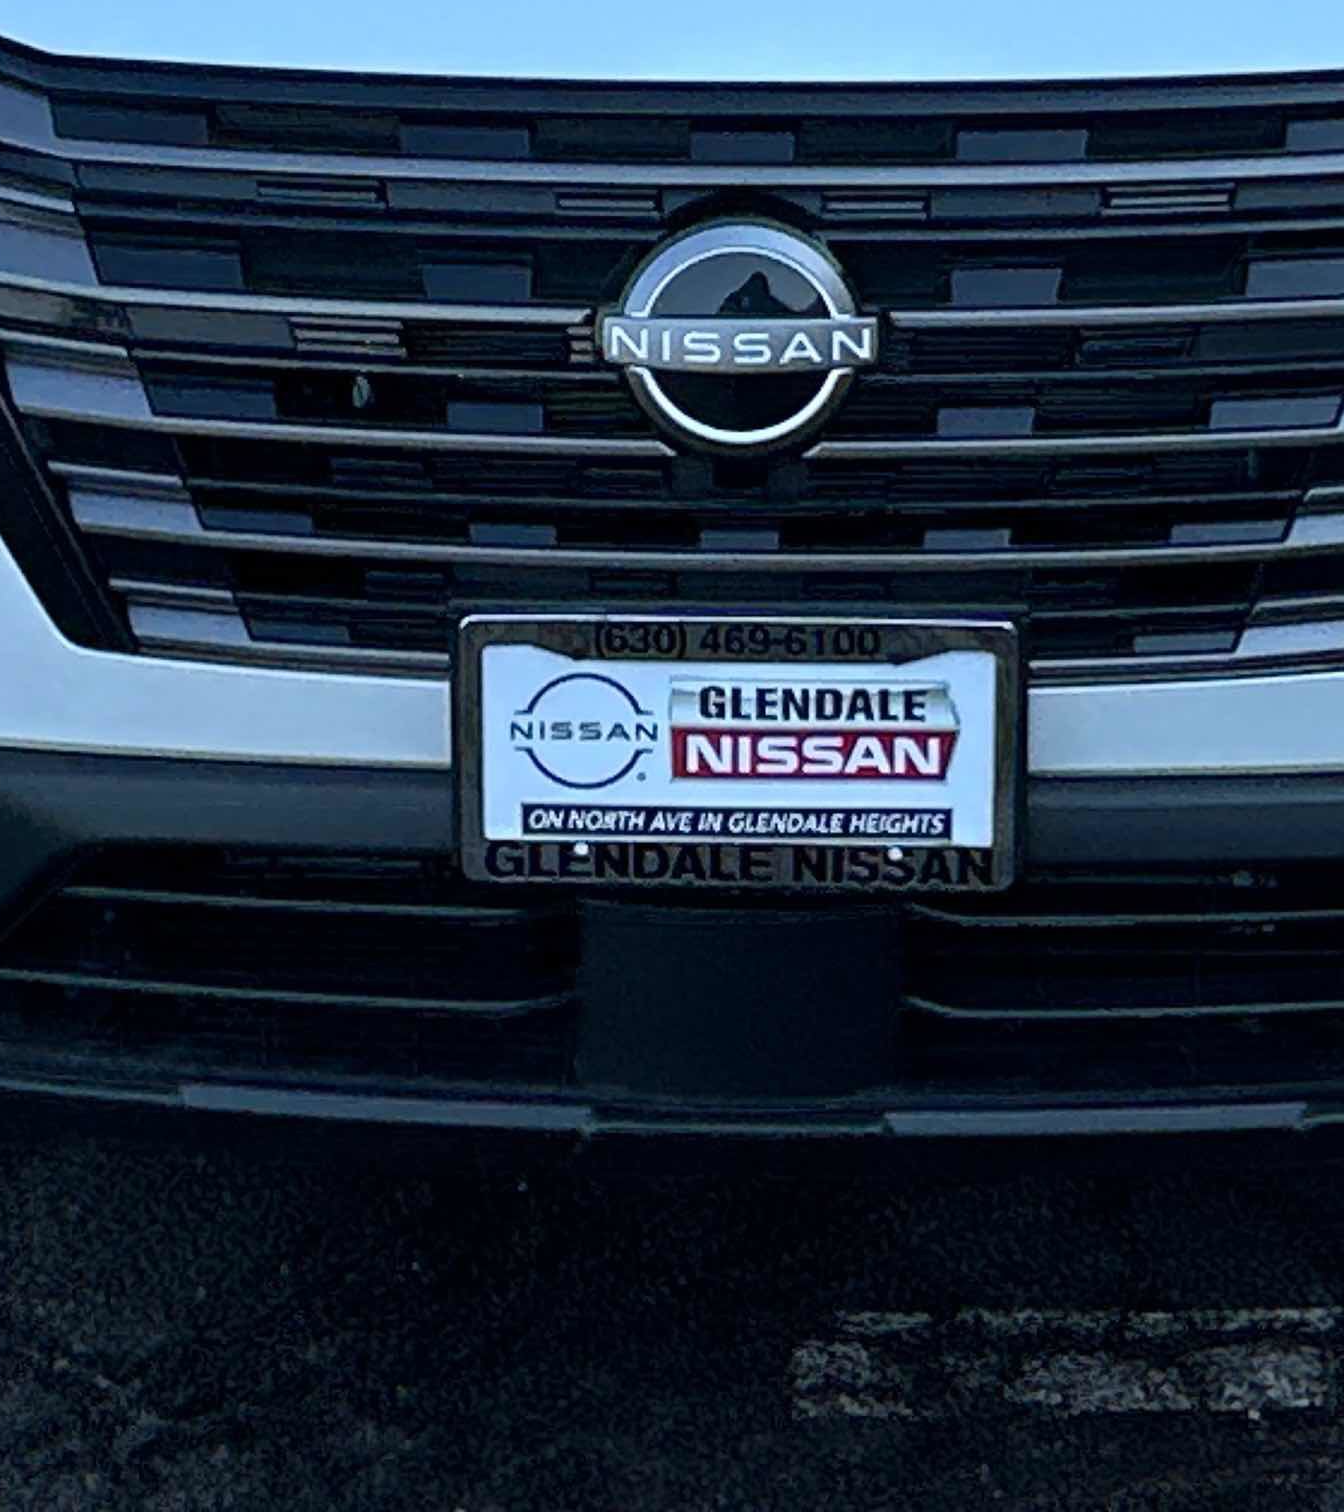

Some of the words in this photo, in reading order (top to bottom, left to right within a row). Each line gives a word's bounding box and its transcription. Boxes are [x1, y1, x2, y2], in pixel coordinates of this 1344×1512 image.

[610, 325, 871, 365] NISSAN
[594, 622, 687, 659] (630)
[700, 624, 881, 657] 469-6100
[699, 685, 927, 723] GLENDALE
[509, 719, 659, 743] NISSAN
[684, 734, 943, 777] NISSAN
[528, 808, 564, 830] ON
[567, 809, 646, 832] NORTH
[648, 810, 694, 833] AVE
[697, 811, 723, 833] IN
[728, 812, 844, 834] GLENDALE
[848, 813, 945, 835] HEIGHTS
[484, 840, 774, 882] GLENDALE
[792, 845, 994, 886] NISSAN
